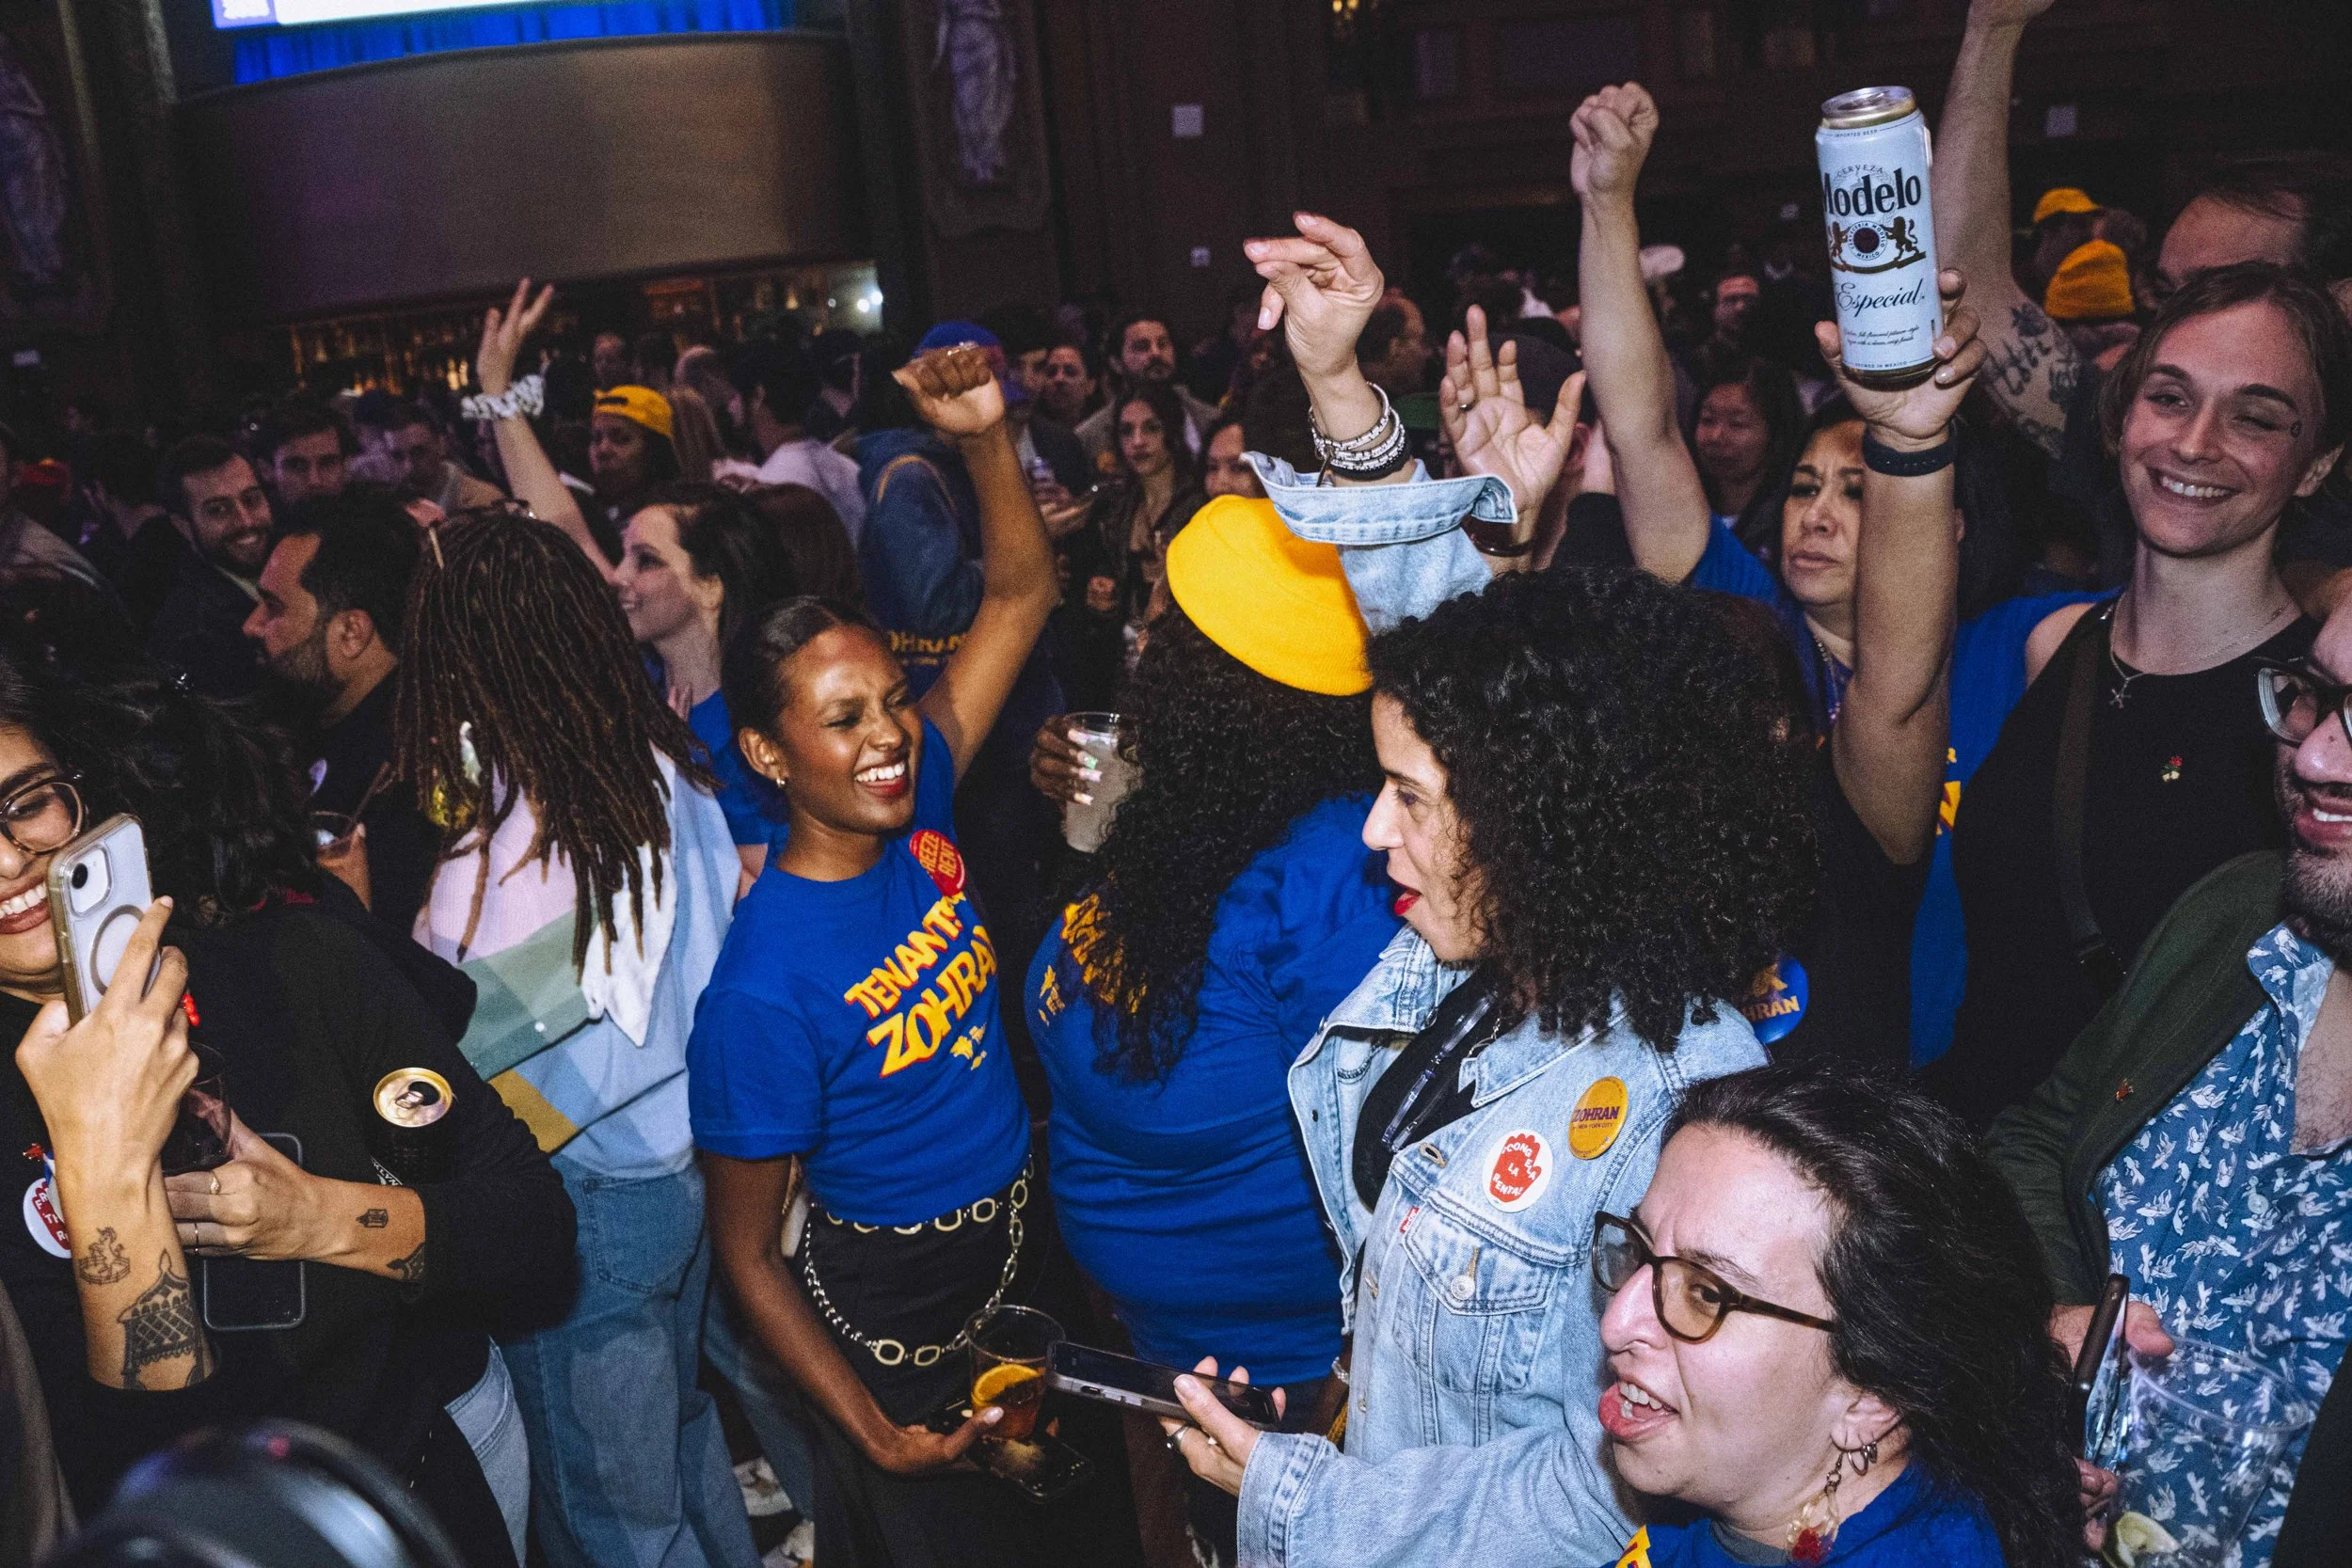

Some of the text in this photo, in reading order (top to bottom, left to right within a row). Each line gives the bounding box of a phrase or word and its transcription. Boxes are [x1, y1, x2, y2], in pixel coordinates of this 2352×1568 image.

[1836, 164, 1883, 178] CERVEZA
[1837, 277, 1923, 318] Especial
[1571, 1106, 1620, 1123] ZOHRAN
[1507, 1162, 1519, 1178] LA
[1492, 1172, 1524, 1196] RENTA!
